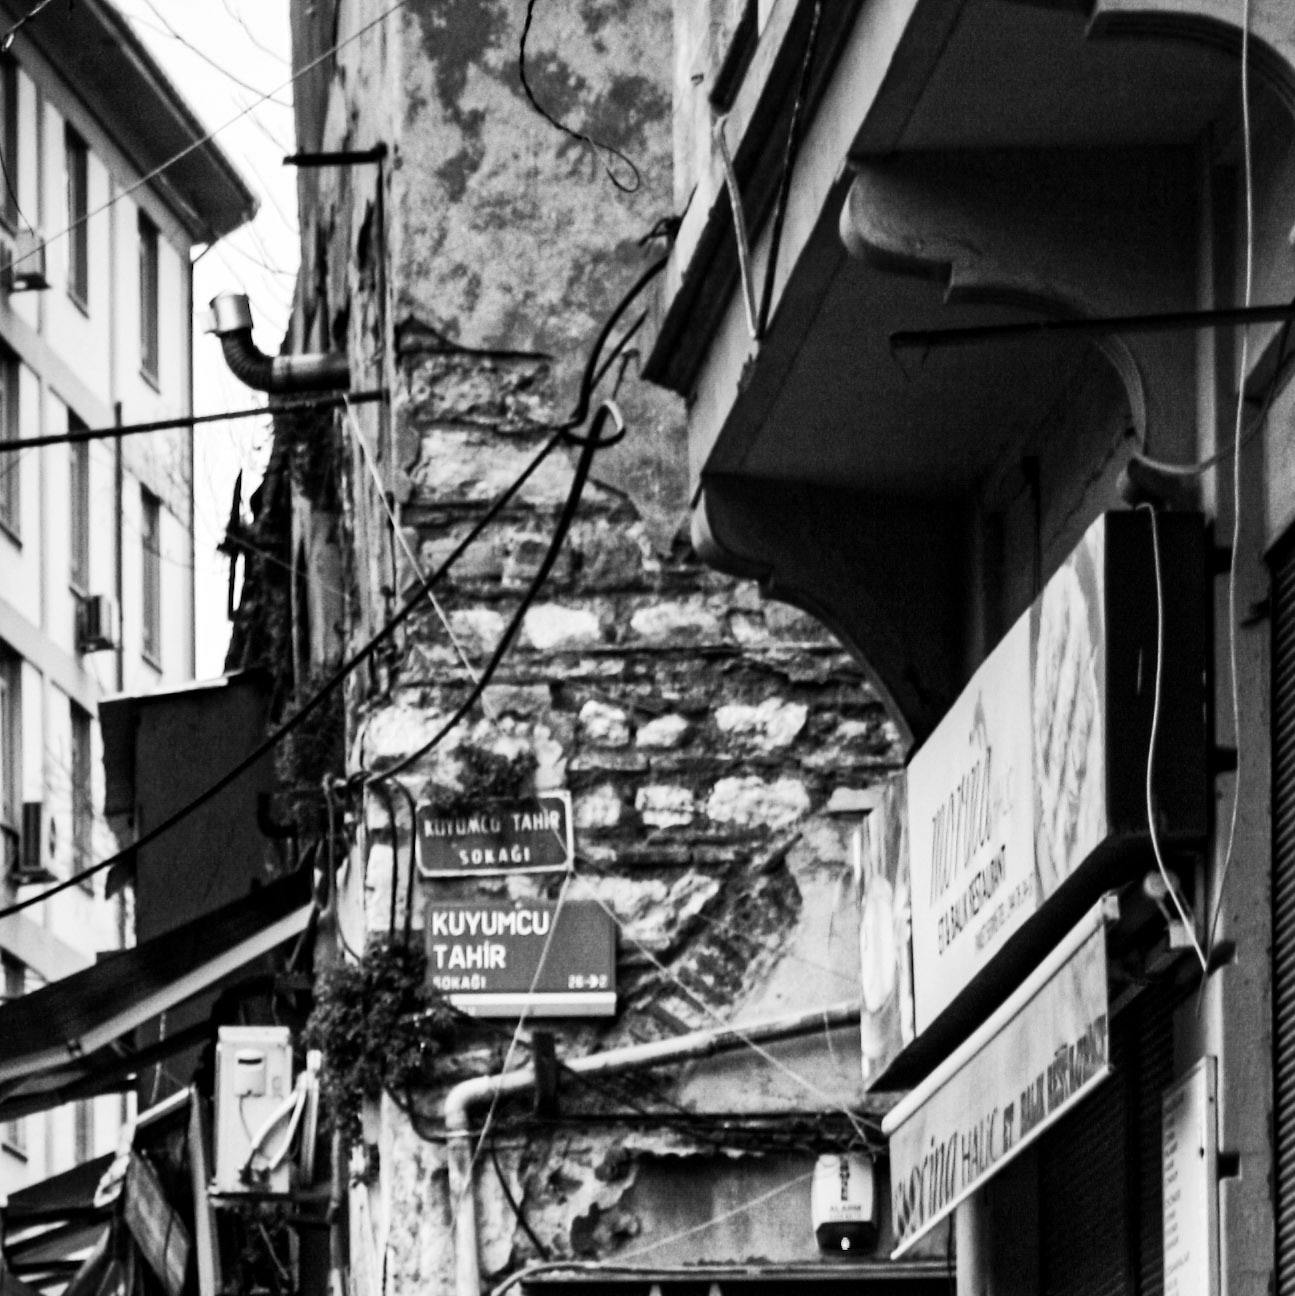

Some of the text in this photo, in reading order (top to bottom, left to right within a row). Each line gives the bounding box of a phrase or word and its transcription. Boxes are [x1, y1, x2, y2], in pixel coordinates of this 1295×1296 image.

[459, 844, 531, 865] SOKAĞI
[432, 909, 550, 936] KUYUMCU
[433, 939, 507, 969] TAHİR
